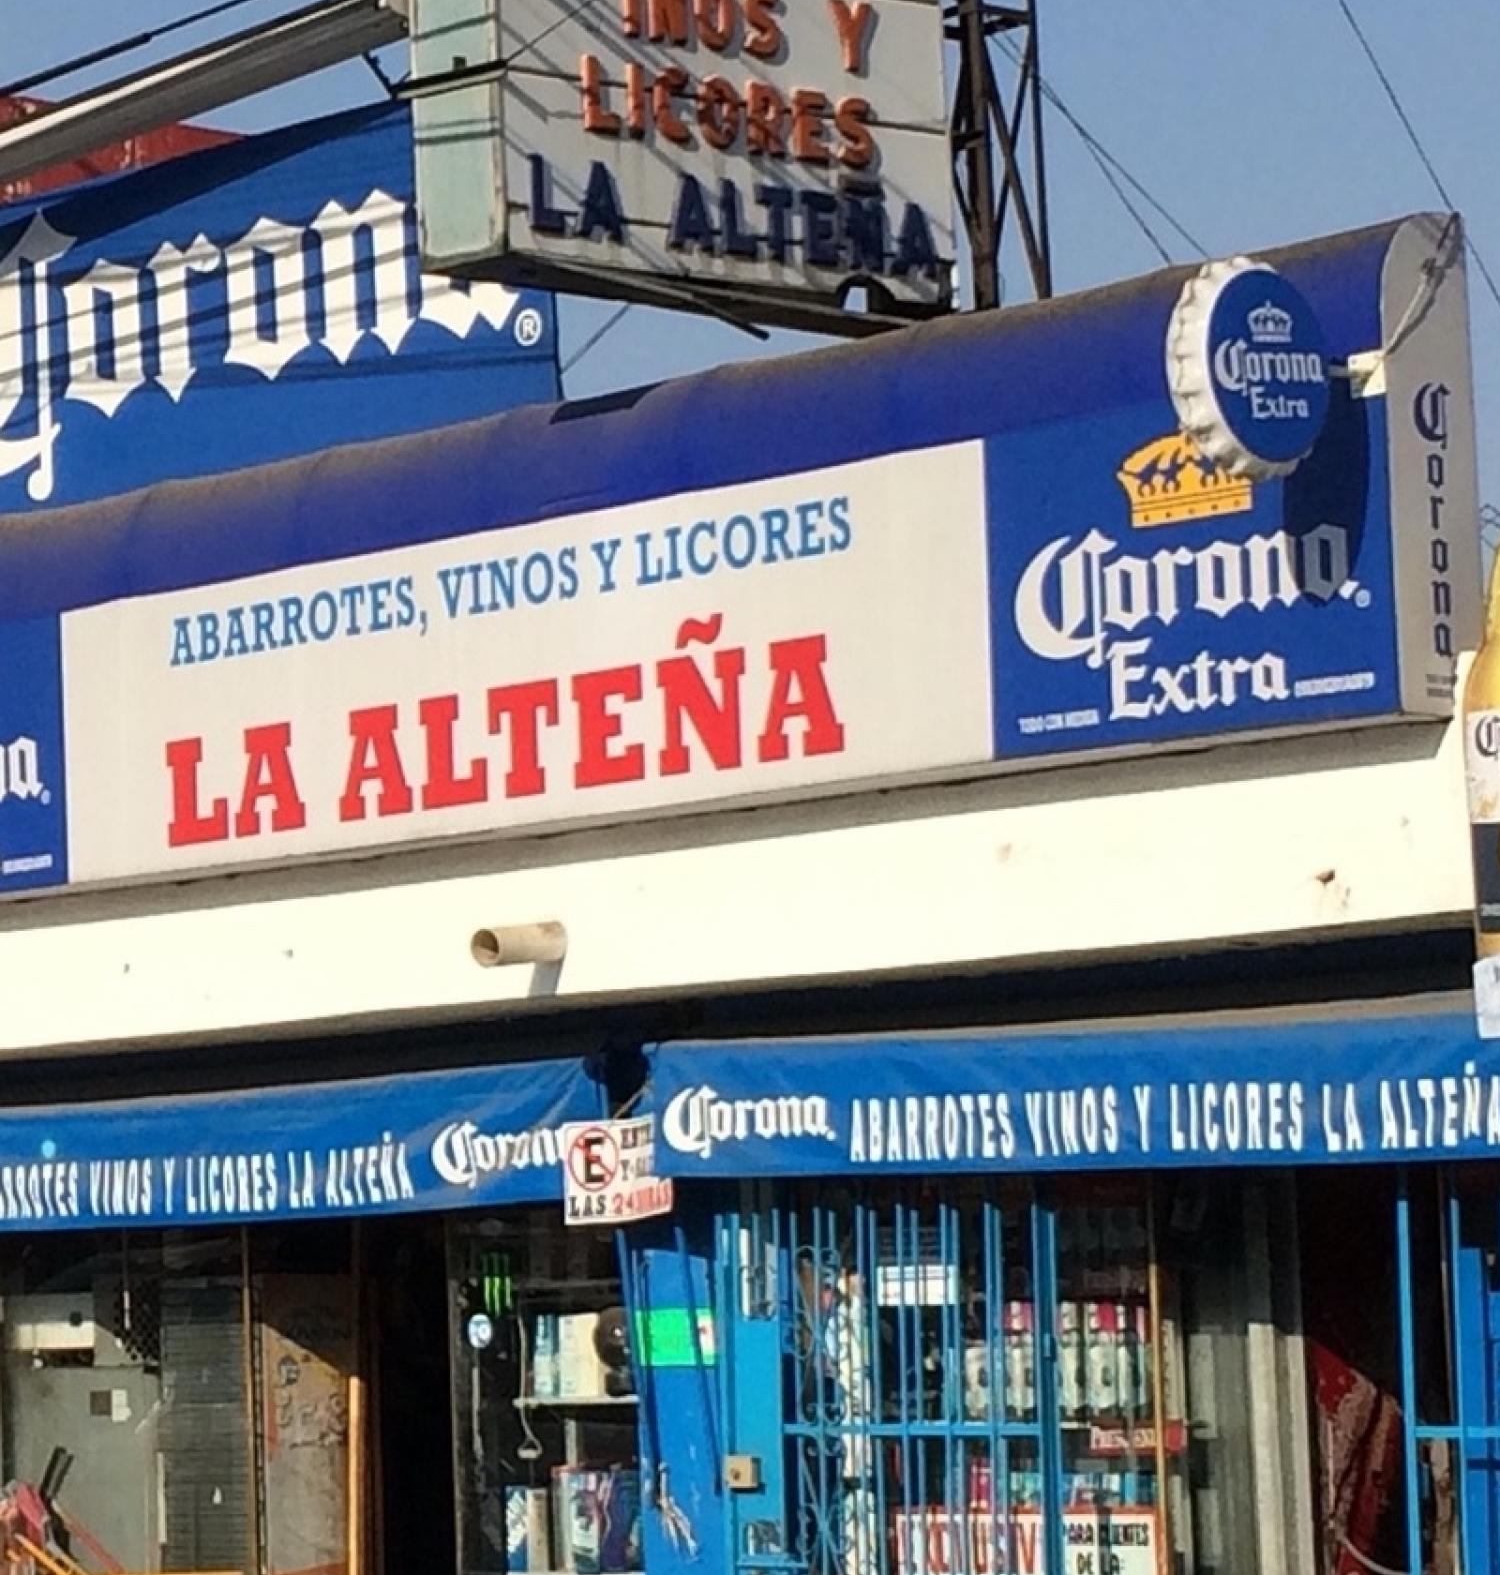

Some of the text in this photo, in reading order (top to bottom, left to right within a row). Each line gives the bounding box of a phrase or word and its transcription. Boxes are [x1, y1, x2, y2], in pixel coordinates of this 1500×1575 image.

[579, 52, 877, 171] LICORES
[525, 153, 624, 244] LA
[1214, 337, 1326, 397] Corona
[1249, 386, 1310, 420] Extra
[1412, 381, 1453, 658] Corona
[170, 496, 853, 667] ABARROTES, VINOS Y LICORES
[1014, 522, 1357, 669] Corona
[1107, 637, 1290, 721] Extra
[165, 721, 308, 849] LA
[338, 612, 846, 823] ALTEÑA
[431, 1120, 559, 1190] Coron
[662, 1083, 832, 1159] Corona
[849, 1091, 1016, 1163] ABARROTES
[1024, 1084, 1120, 1158] VINOS
[1133, 1083, 1152, 1153] Y
[1169, 1080, 1302, 1153] LICORES
[1322, 1082, 1365, 1153] LA
[89, 1157, 153, 1217] VINOS
[163, 1156, 176, 1215] Y
[186, 1151, 278, 1214] LICORES
[288, 1149, 316, 1209] LA
[568, 1194, 607, 1218] LAS
